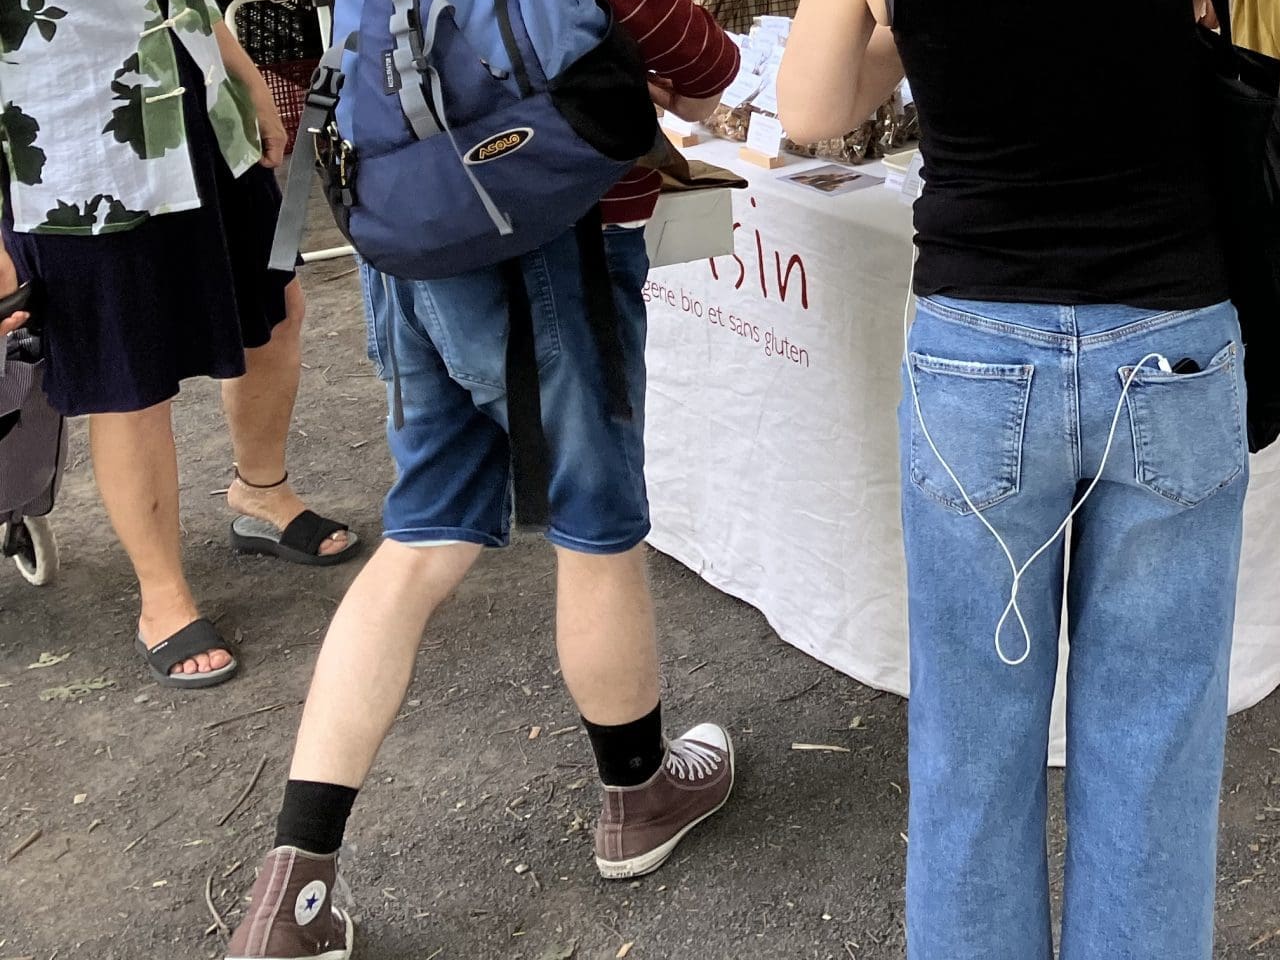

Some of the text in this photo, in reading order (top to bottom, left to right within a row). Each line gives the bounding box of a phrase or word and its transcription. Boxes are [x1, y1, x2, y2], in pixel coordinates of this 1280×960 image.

[479, 133, 520, 159] ASOLO
[642, 280, 810, 368] gerie bio et sans gluten
